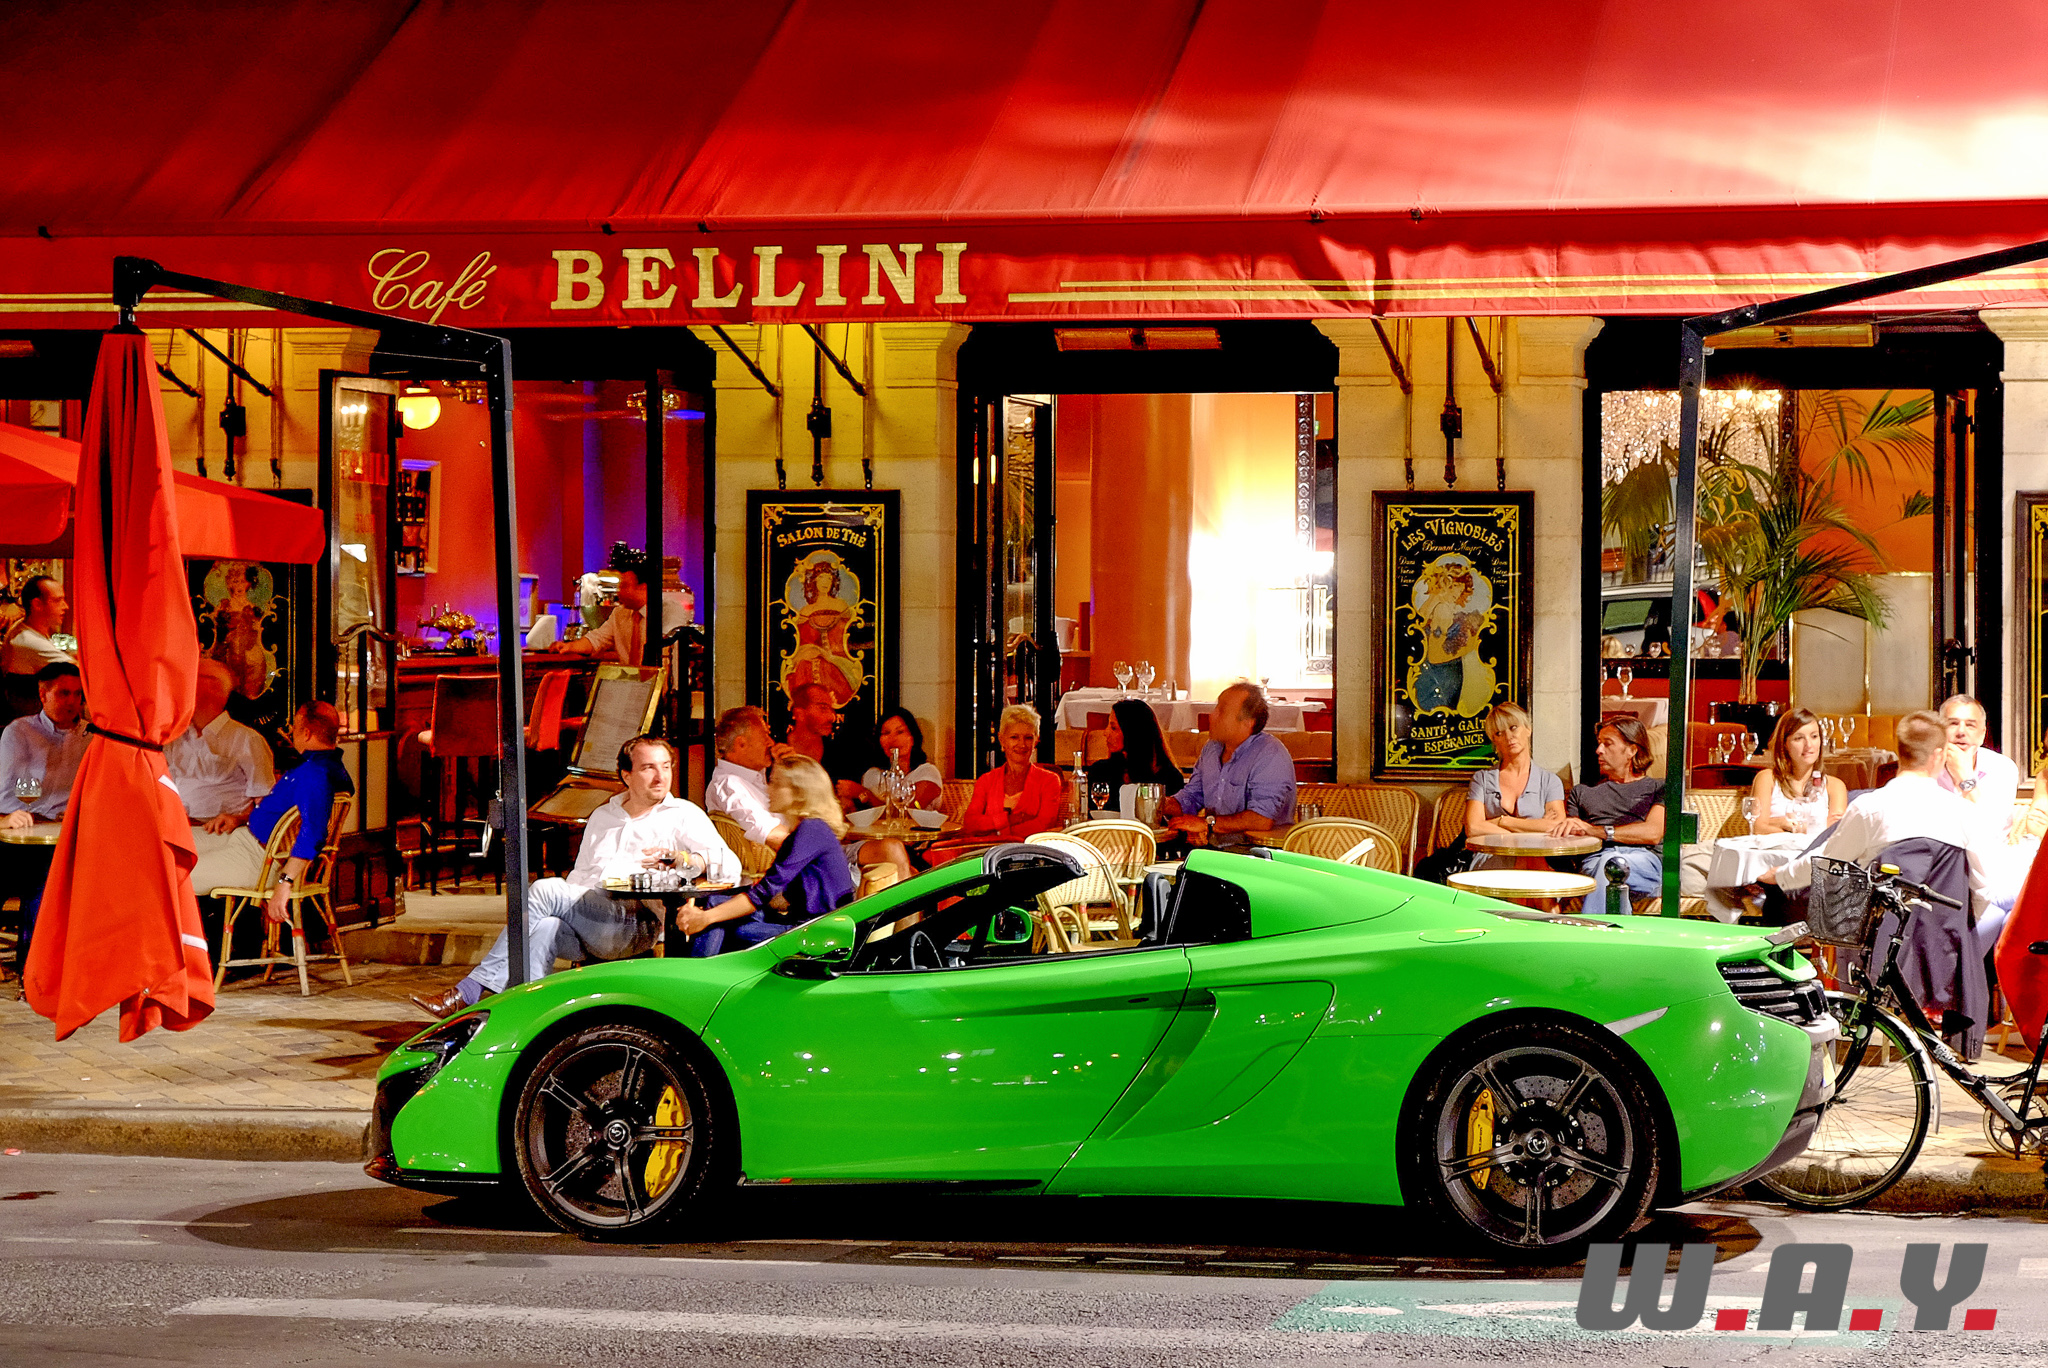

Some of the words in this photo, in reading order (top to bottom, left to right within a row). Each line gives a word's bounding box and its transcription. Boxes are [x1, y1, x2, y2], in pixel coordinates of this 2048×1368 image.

[366, 247, 498, 325] Café
[550, 242, 968, 310] BELLINI
[776, 527, 824, 548] SALON
[826, 527, 840, 539] DE
[841, 527, 867, 548] THÉ
[1401, 529, 1427, 551] LES
[1410, 719, 1448, 738] SANTÉ
[1424, 734, 1485, 752] ESPÉRANCE
